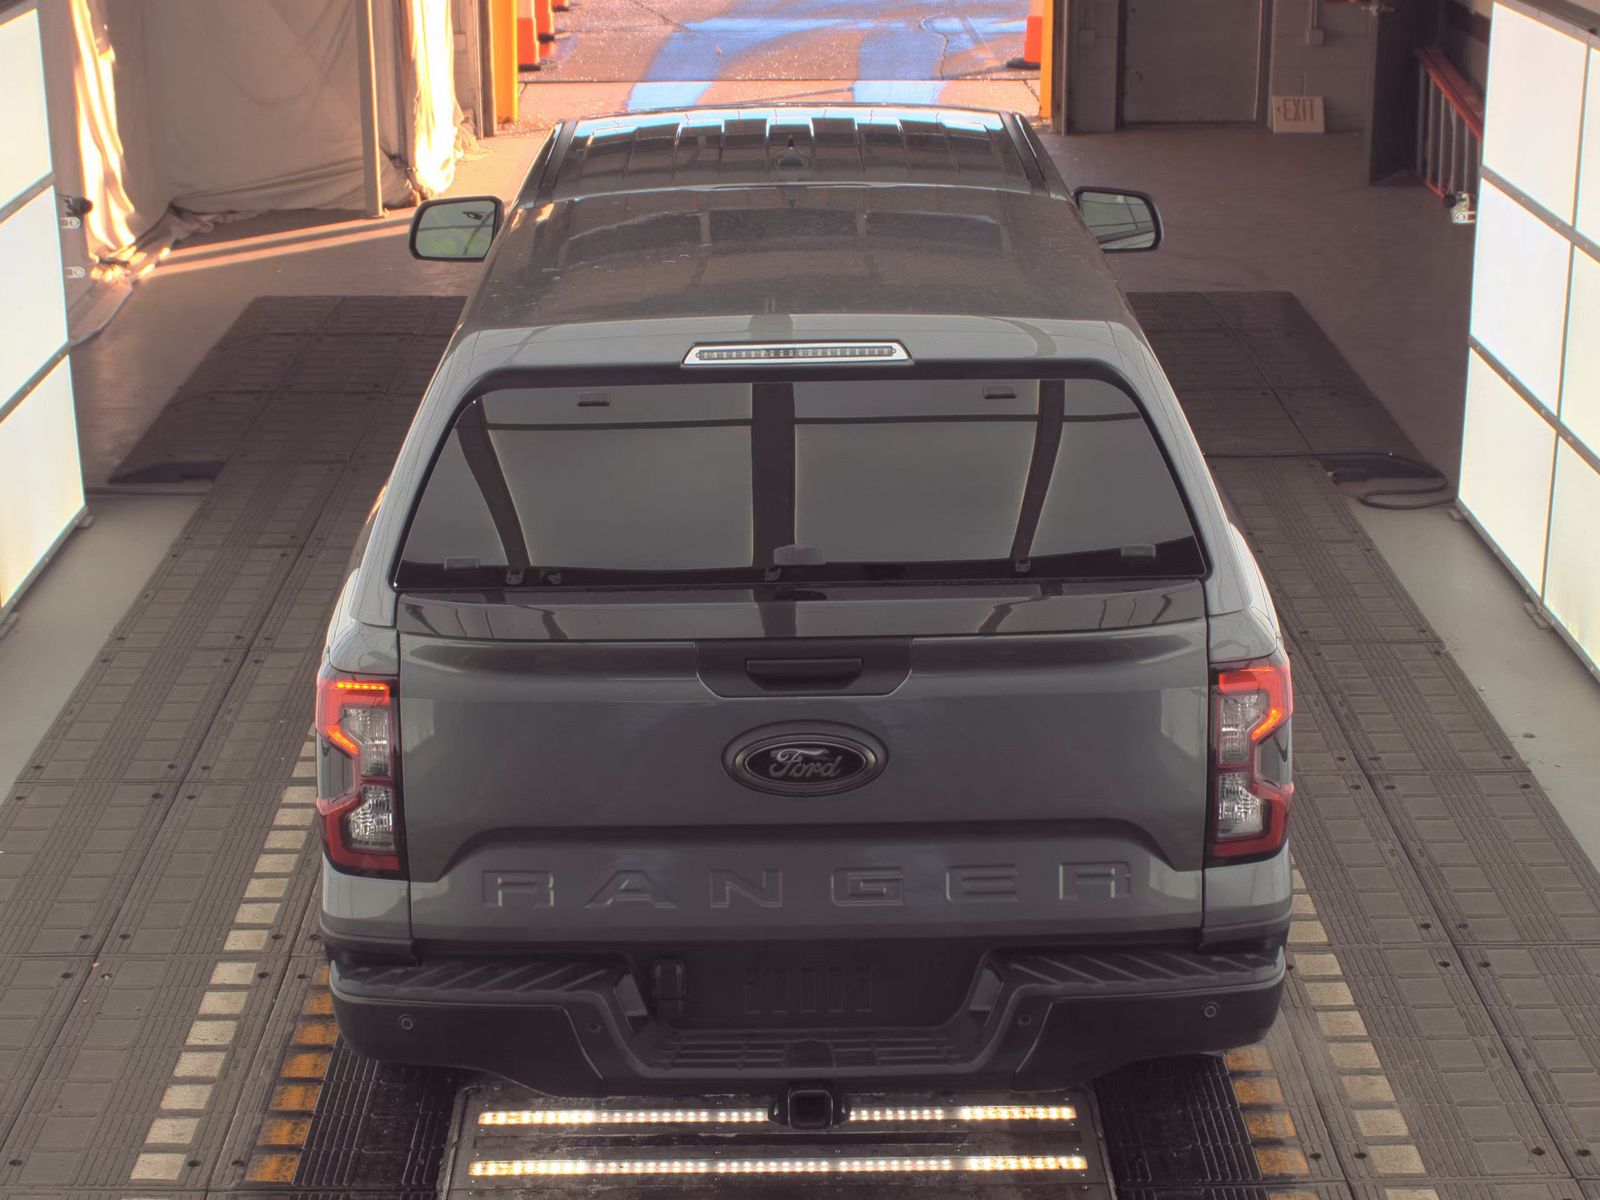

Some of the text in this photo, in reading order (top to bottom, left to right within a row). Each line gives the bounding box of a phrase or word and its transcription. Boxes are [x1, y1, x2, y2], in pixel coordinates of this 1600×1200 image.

[1283, 98, 1316, 121] EXIT
[769, 748, 843, 777] Ford
[481, 860, 1133, 910] RANGER
